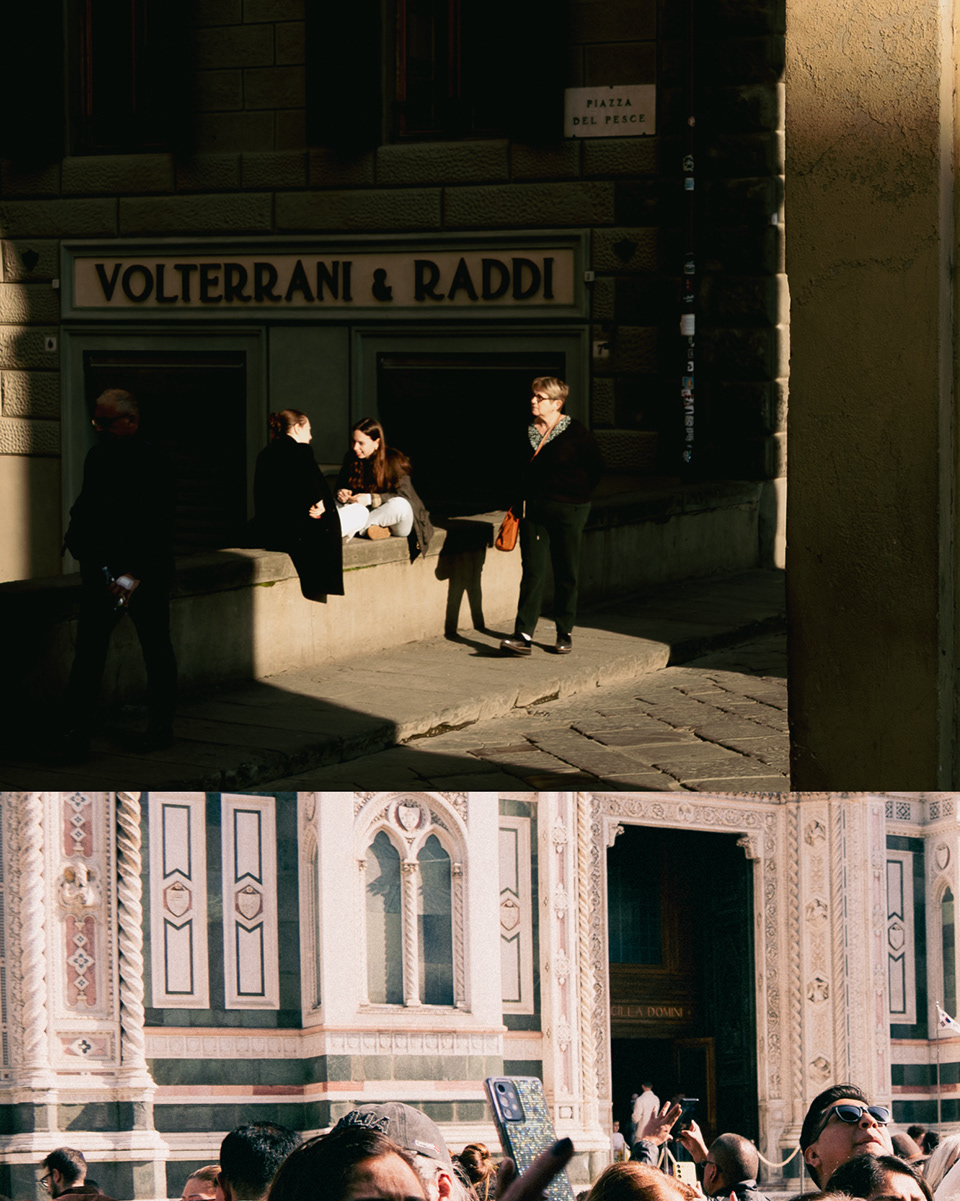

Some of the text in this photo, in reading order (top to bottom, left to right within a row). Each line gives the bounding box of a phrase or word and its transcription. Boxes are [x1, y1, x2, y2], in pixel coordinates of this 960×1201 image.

[586, 98, 632, 108] PIAZZA
[572, 114, 646, 126] DEL PESCE
[95, 257, 555, 305] VOLTERRANI & RADDI
[647, 1006, 683, 1017] DOMINI
